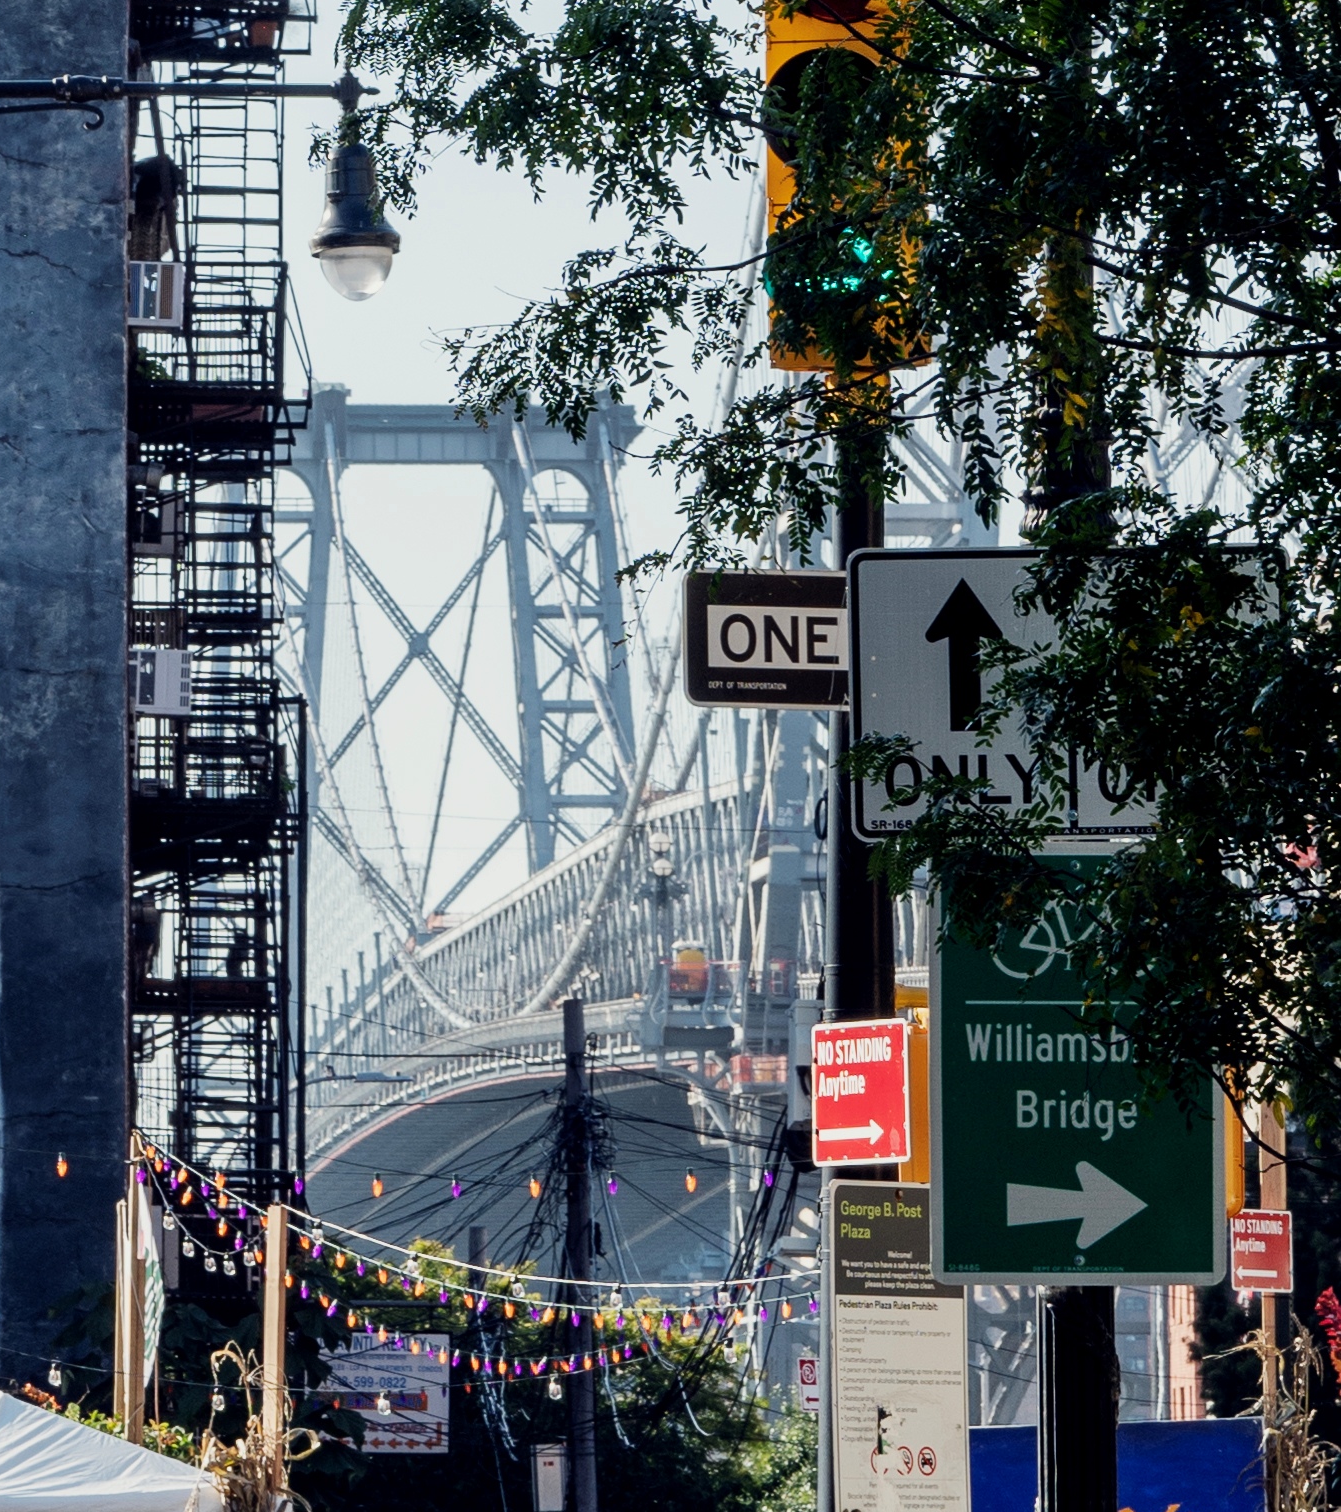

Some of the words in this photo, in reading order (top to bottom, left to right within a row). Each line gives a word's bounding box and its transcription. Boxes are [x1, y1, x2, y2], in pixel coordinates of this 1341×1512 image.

[720, 613, 840, 665] ONE
[737, 681, 787, 690] TRANSPORTATION
[817, 1041, 834, 1066] NO
[835, 1036, 892, 1065] STANDING
[965, 1023, 1138, 1063] Williamsb
[818, 1070, 866, 1102] Anytime
[1016, 1089, 1138, 1142] Bridge
[840, 1201, 882, 1220] George
[883, 1202, 895, 1217] B.
[897, 1203, 922, 1218] Post
[840, 1223, 871, 1239] Plaza
[1234, 1219, 1246, 1233] NO
[1247, 1219, 1284, 1235] STANDING
[1235, 1237, 1266, 1255] Anytime
[839, 1299, 874, 1309] Pedestrian
[874, 1300, 892, 1310] Plaza
[893, 1301, 911, 1310] Rules
